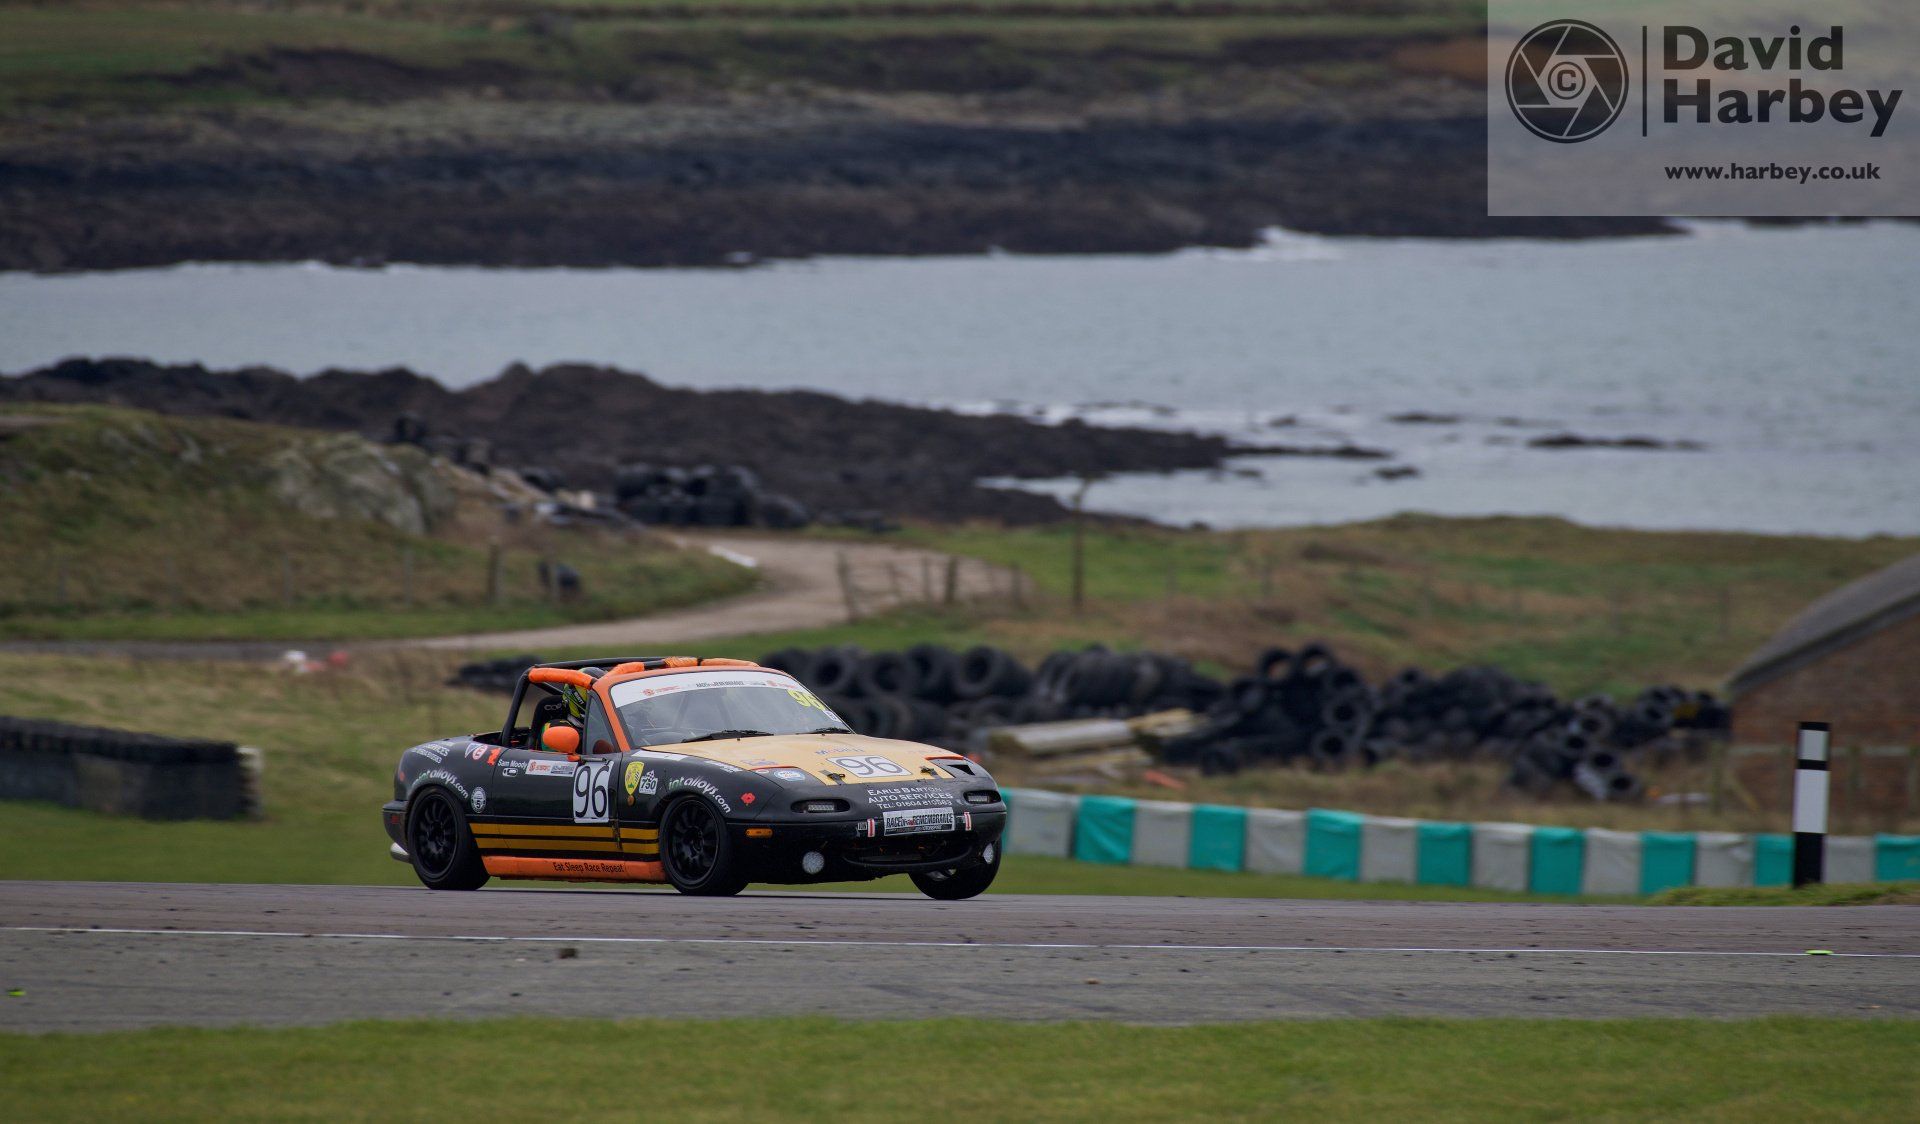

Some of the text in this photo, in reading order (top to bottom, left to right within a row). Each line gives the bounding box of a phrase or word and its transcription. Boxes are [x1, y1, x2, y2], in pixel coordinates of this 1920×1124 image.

[786, 688, 827, 711] 96
[498, 759, 510, 767] Sam
[510, 760, 528, 771] Moody
[835, 756, 903, 776] 96
[640, 778, 657, 790] 750
[575, 765, 608, 818] 96
[867, 788, 900, 796] EARLS
[868, 793, 954, 804] AUTO SERVICES
[553, 862, 625, 874] Eat Sleep Race Repeat
